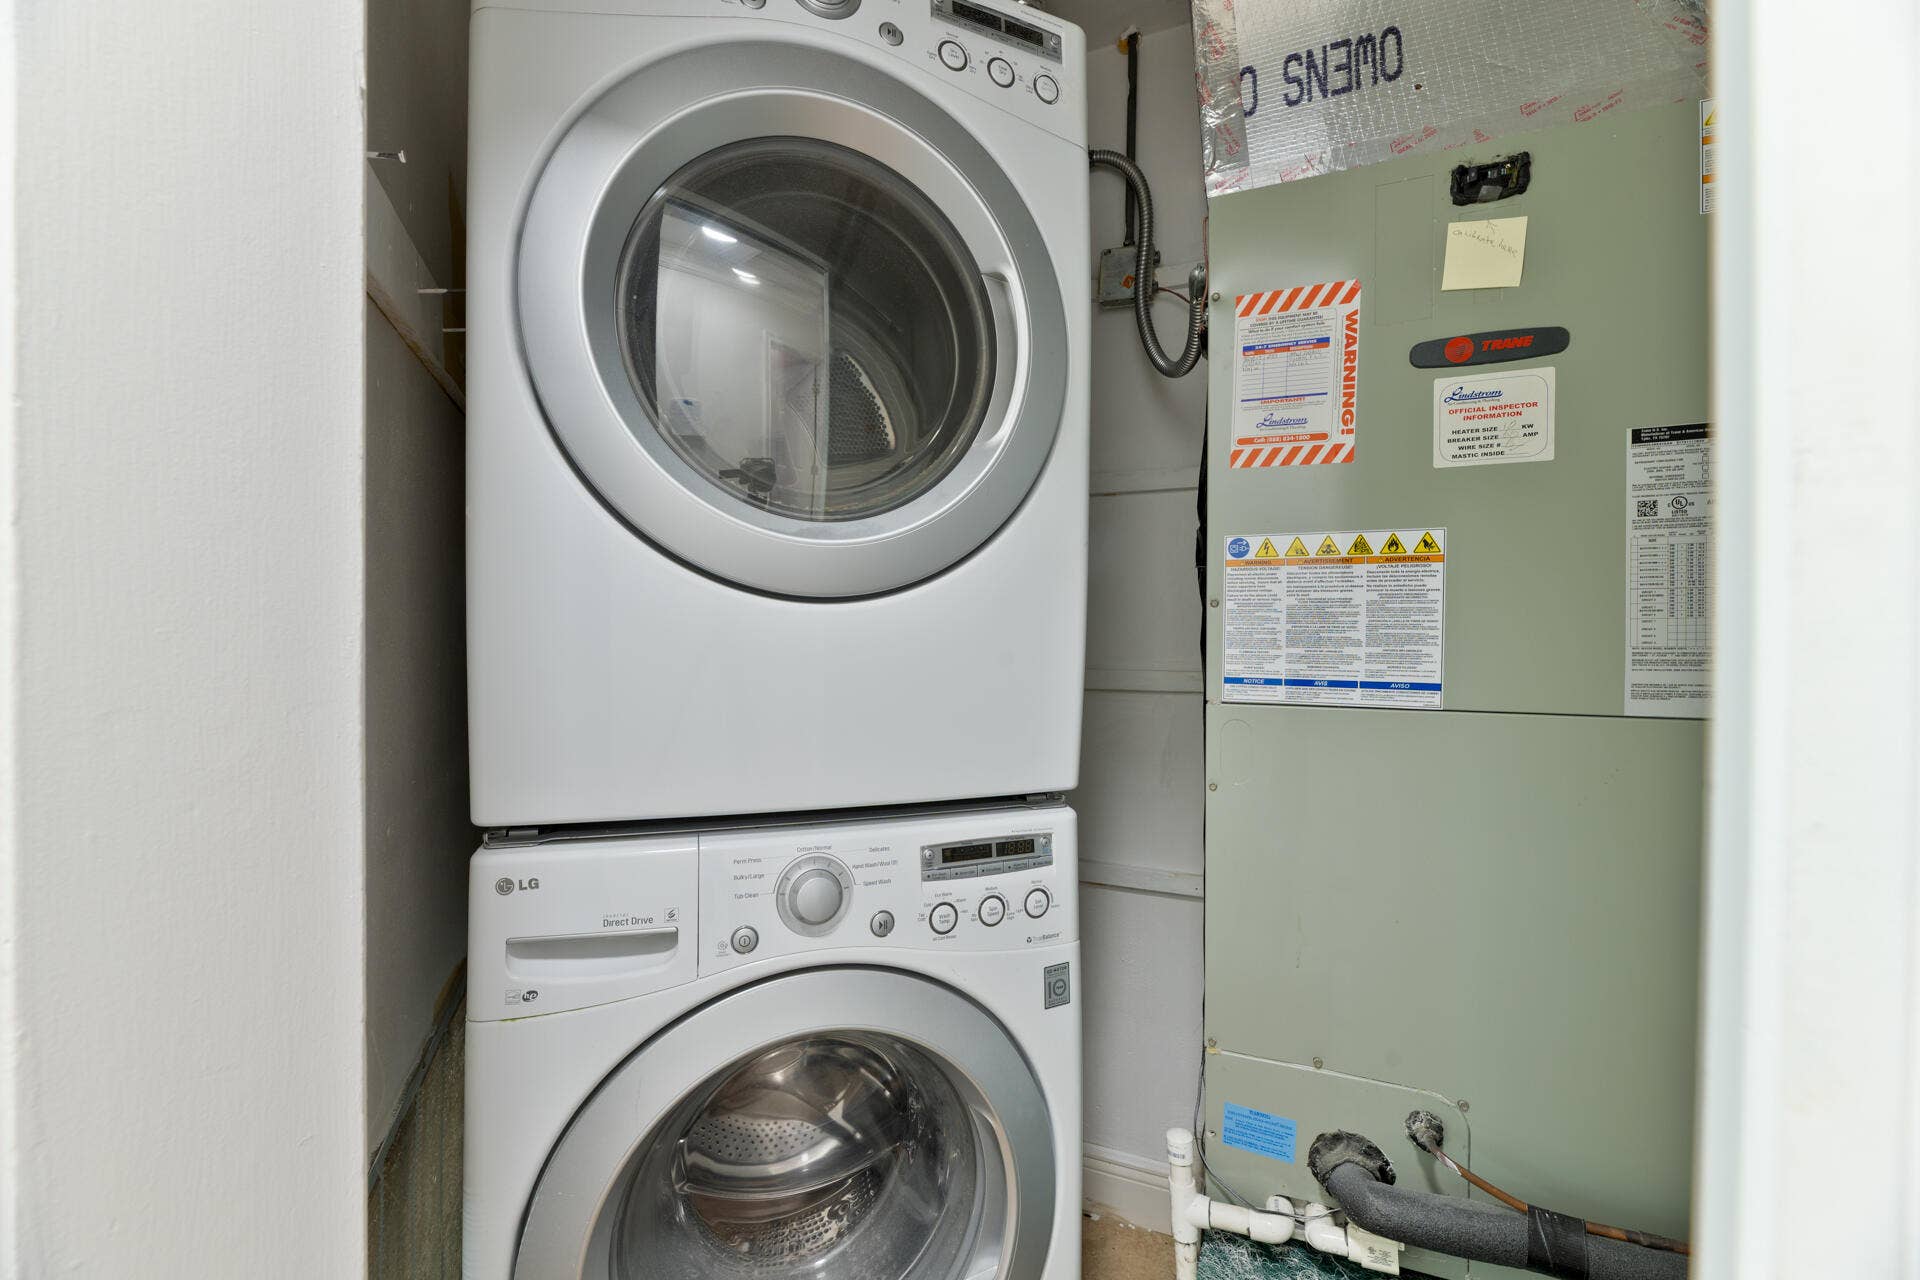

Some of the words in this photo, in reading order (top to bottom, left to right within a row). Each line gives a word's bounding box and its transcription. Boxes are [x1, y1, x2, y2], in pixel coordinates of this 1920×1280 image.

[1283, 26, 1404, 107] OWENS
[1481, 335, 1535, 352] TRANE
[1340, 309, 1359, 436] WARNING!
[1448, 406, 1487, 415] OFFICIAL
[1488, 401, 1539, 411] INSPECTOR
[1463, 410, 1523, 421] INFORMATION
[1451, 427, 1481, 435] HEATER
[1447, 436, 1481, 444] BREAKER
[1458, 443, 1477, 451] WIRE
[1451, 452, 1479, 460] MASTIC
[1384, 555, 1431, 563] ADVERTENCIA
[519, 878, 540, 891] LG
[603, 917, 630, 928] Direct
[631, 916, 654, 926] Drive
